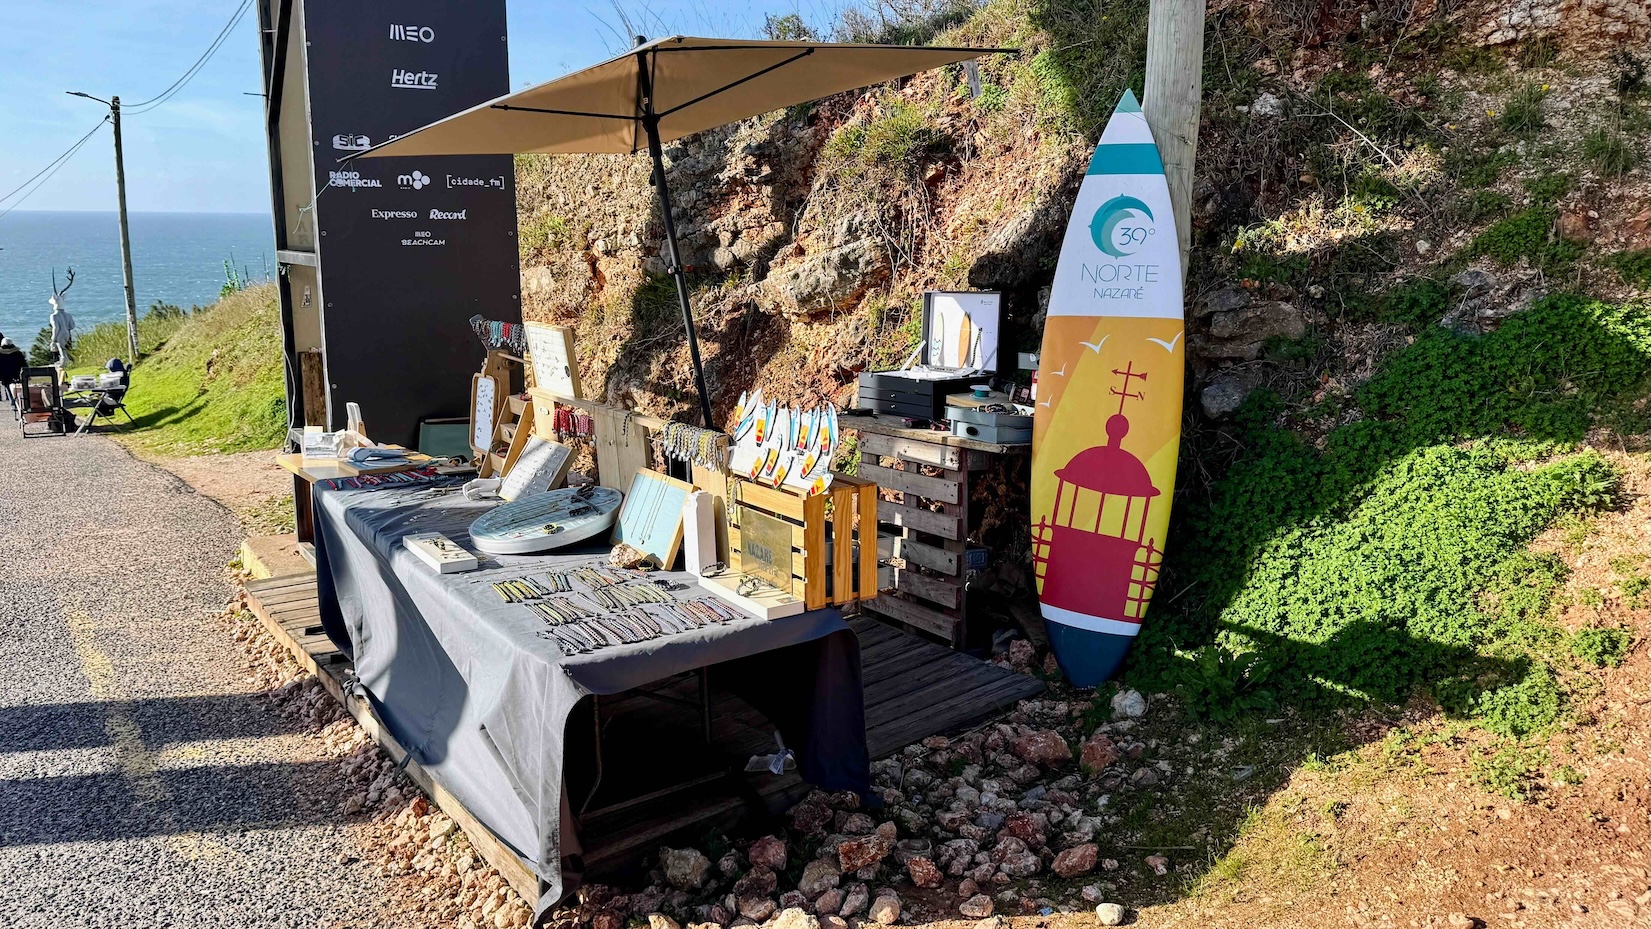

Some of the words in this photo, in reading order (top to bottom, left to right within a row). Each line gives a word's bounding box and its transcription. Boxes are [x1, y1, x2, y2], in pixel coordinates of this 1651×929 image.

[389, 24, 435, 43] MEO
[391, 69, 438, 87] Hertz
[329, 178, 383, 187] COMERCIAL
[371, 209, 418, 220] Expresso
[429, 208, 466, 220] Record
[1081, 263, 1159, 284] NORTE
[1093, 286, 1144, 300] NAZARÉ
